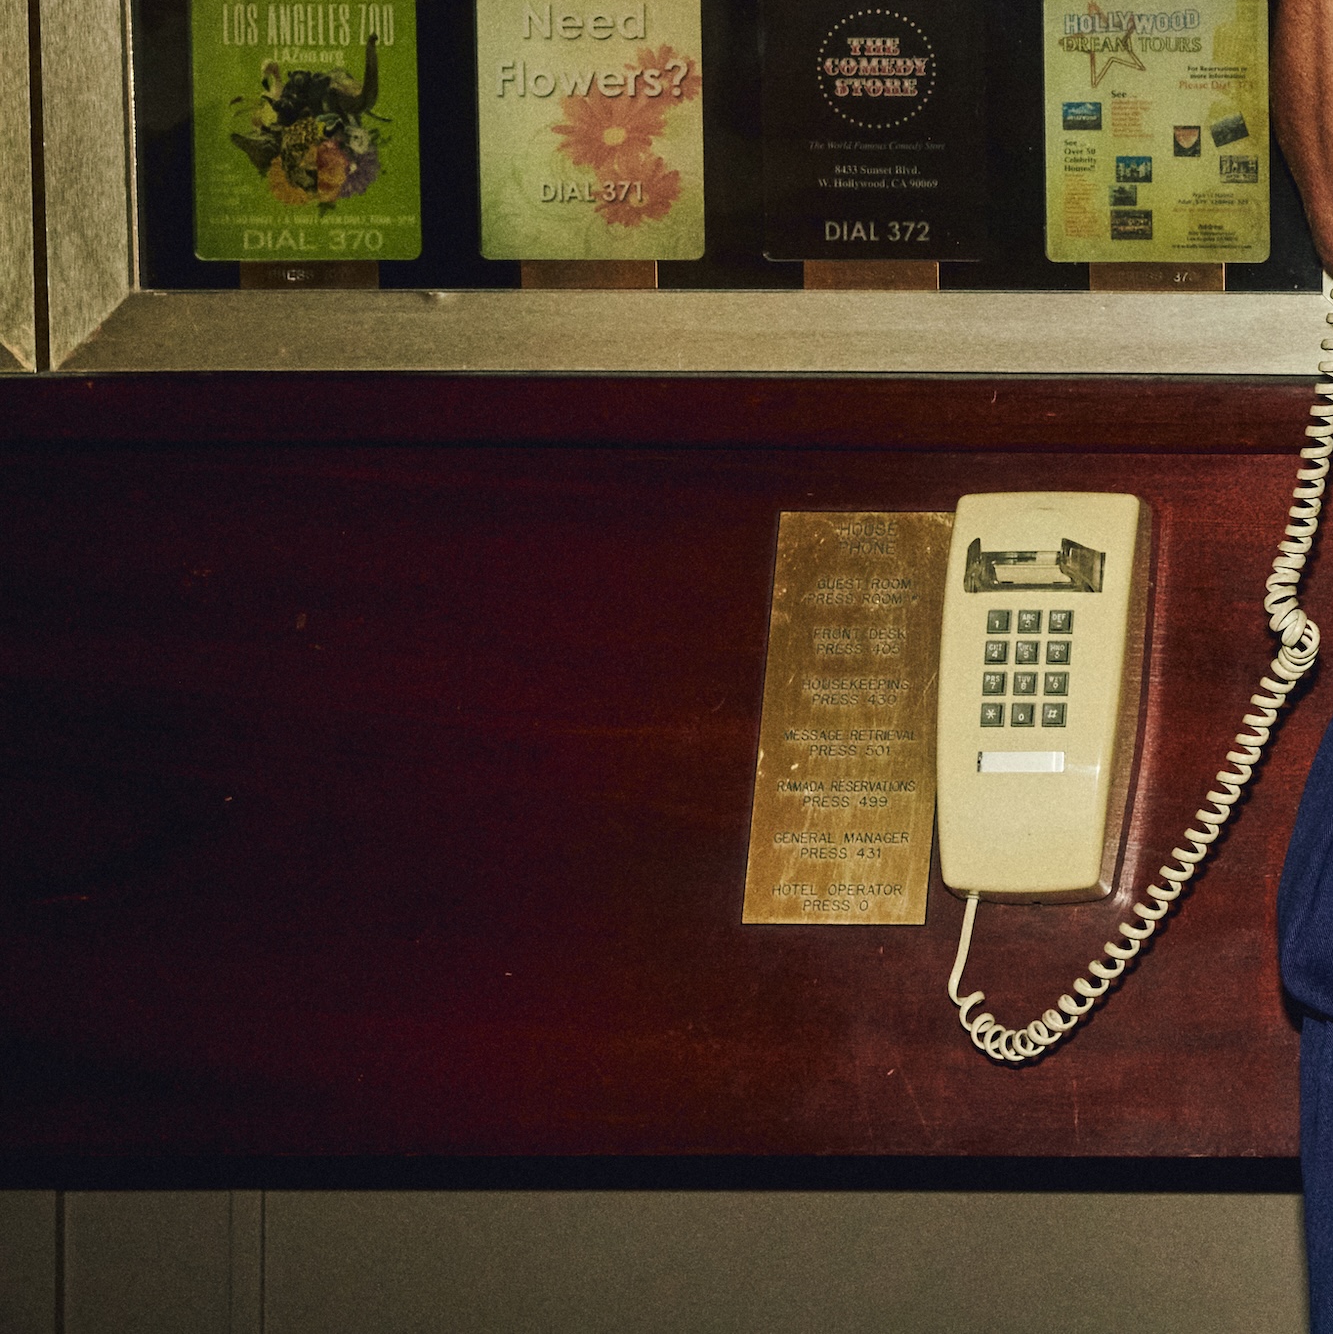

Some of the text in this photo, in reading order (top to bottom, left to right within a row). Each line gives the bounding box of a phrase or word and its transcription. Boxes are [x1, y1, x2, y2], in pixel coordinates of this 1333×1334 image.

[224, 3, 394, 46] LOS ANGELES ZOO
[523, 3, 646, 40] Need
[847, 37, 900, 55] THE
[824, 57, 928, 77] COMEDY
[497, 61, 687, 98] Flowers?
[835, 78, 918, 98] STORE
[773, 832, 909, 843] GENERAL MANAGER
[800, 848, 882, 859] PRESS 431
[773, 885, 902, 896] HOTEL OPERATOR
